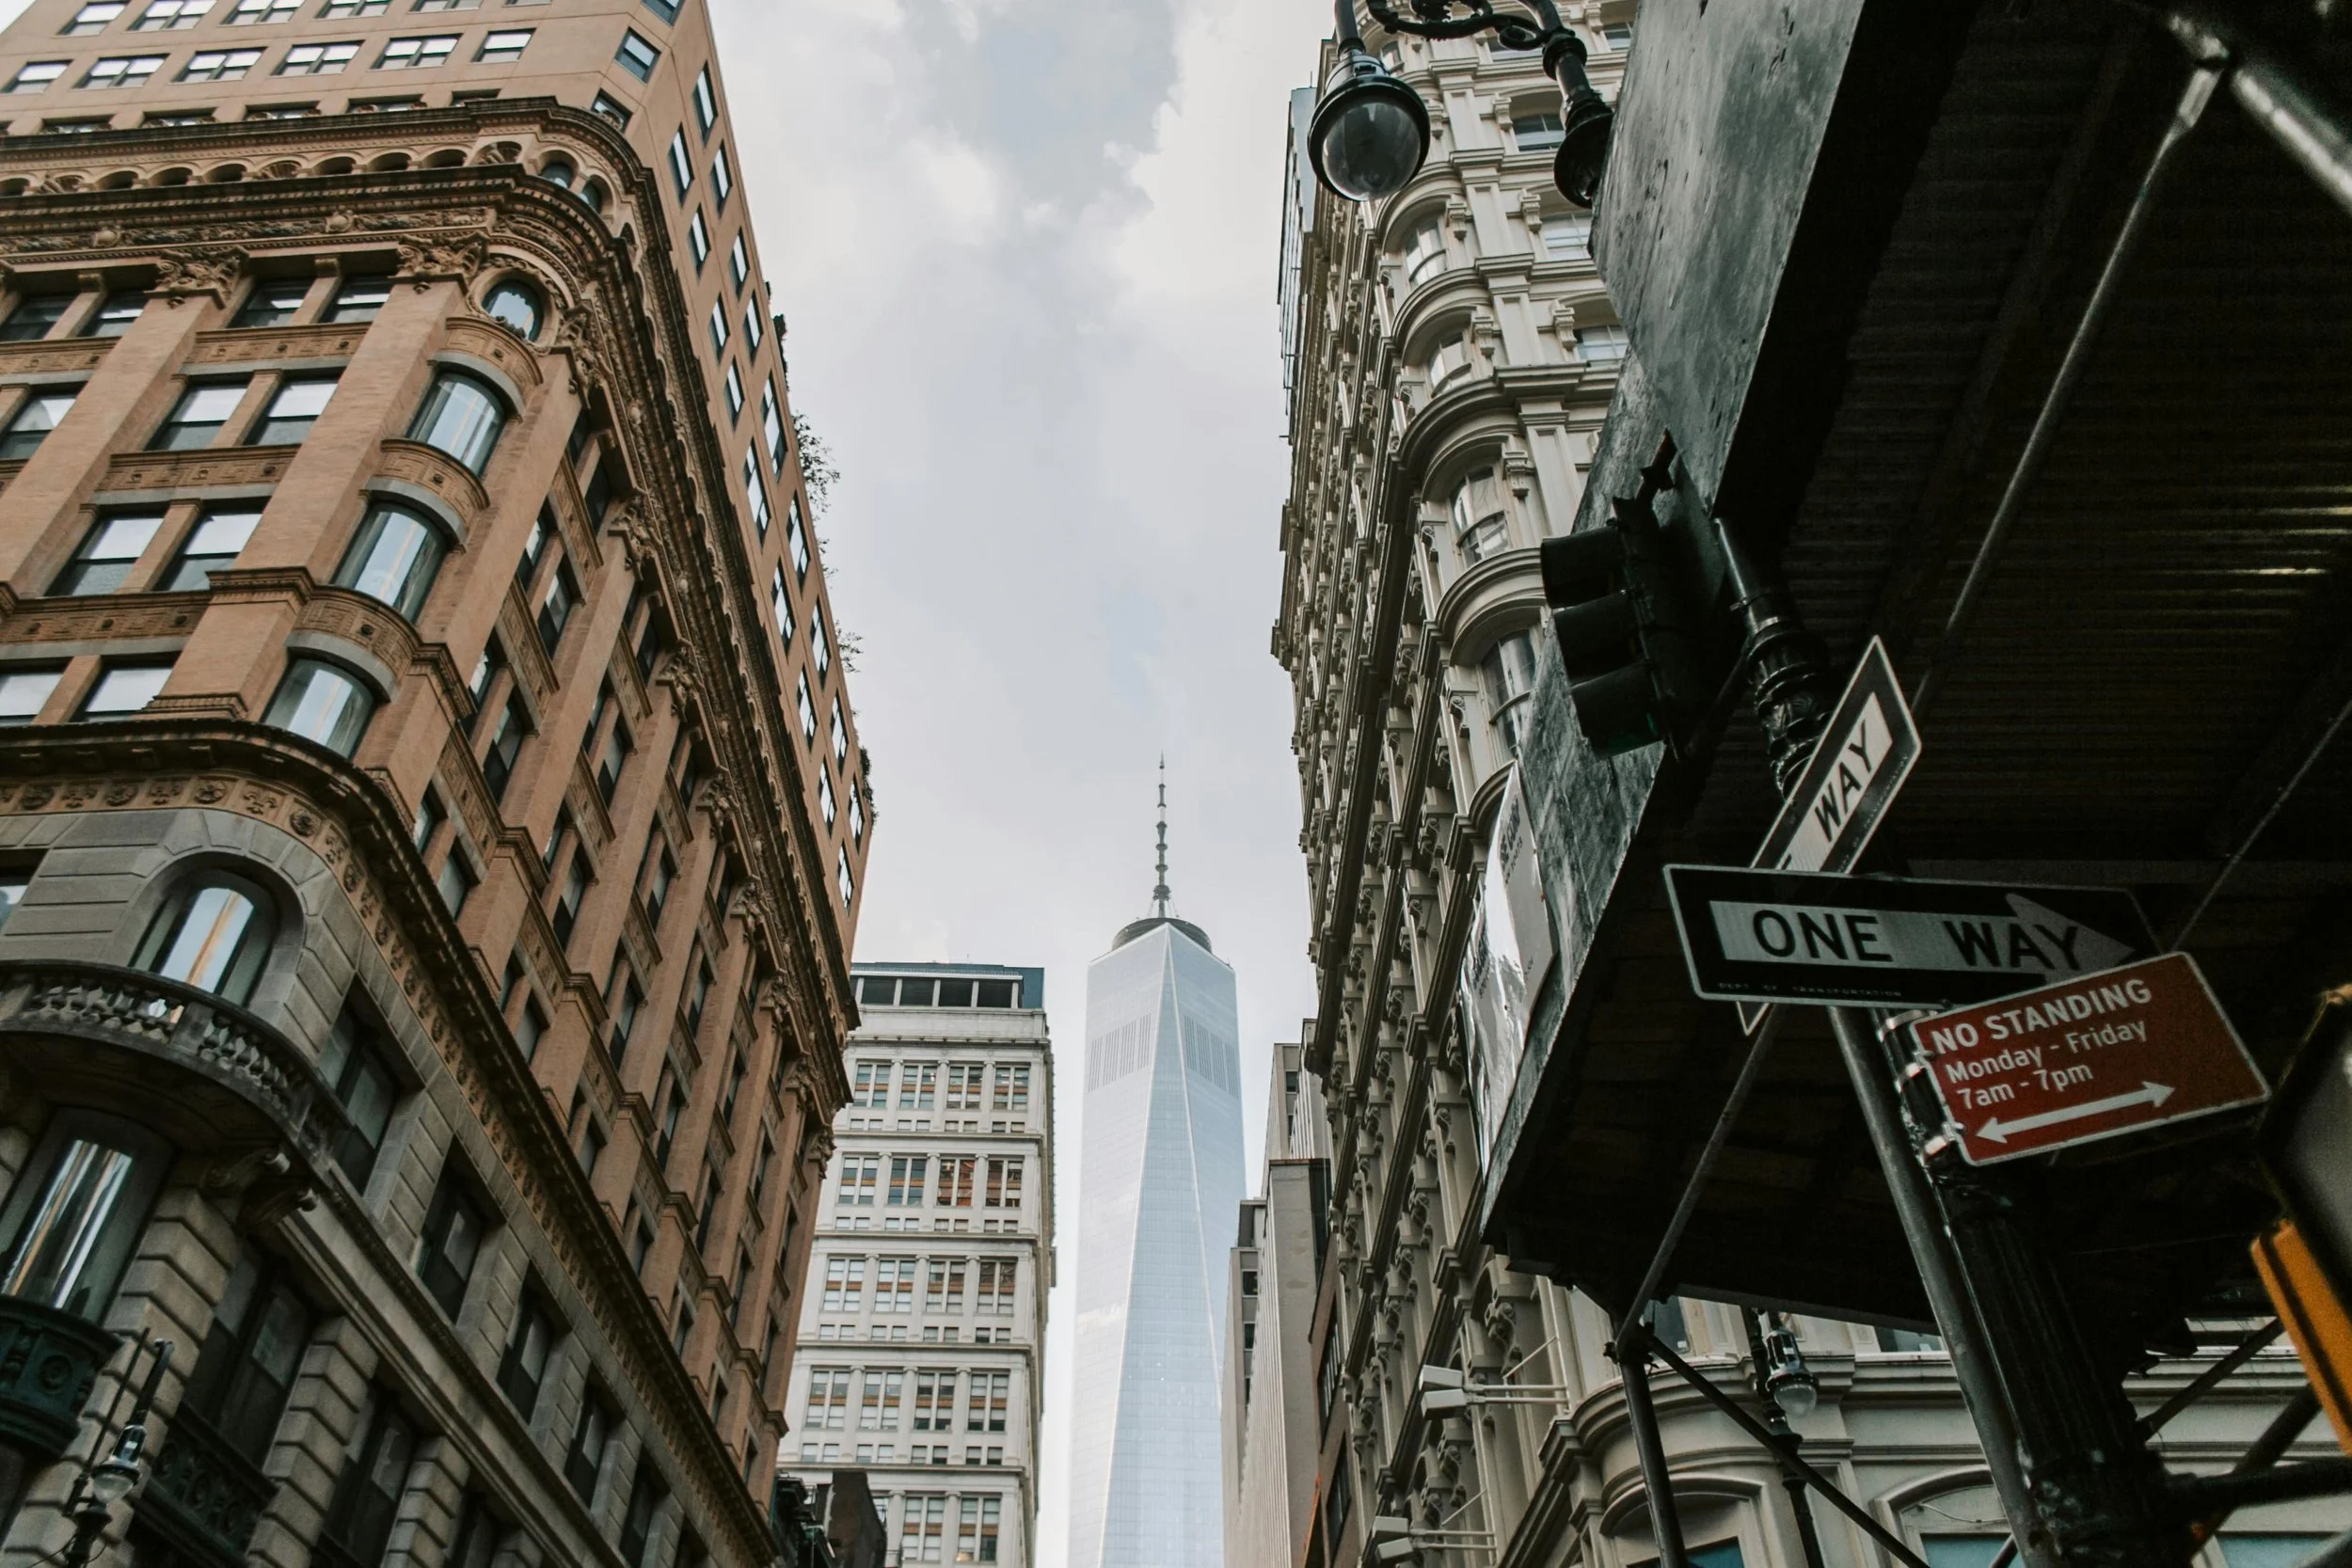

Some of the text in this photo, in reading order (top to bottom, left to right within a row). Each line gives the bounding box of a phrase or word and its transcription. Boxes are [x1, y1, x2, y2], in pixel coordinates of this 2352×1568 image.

[1815, 719, 1871, 843] WAY
[1753, 910, 2079, 970] ONE WAY
[1931, 978, 2153, 1055] NO STANDING
[1945, 1046, 2042, 1084] Monday
[2064, 1020, 2148, 1053] Friday
[1956, 1082, 2016, 1110] 7am
[2032, 1063, 2094, 1092] 7pm
